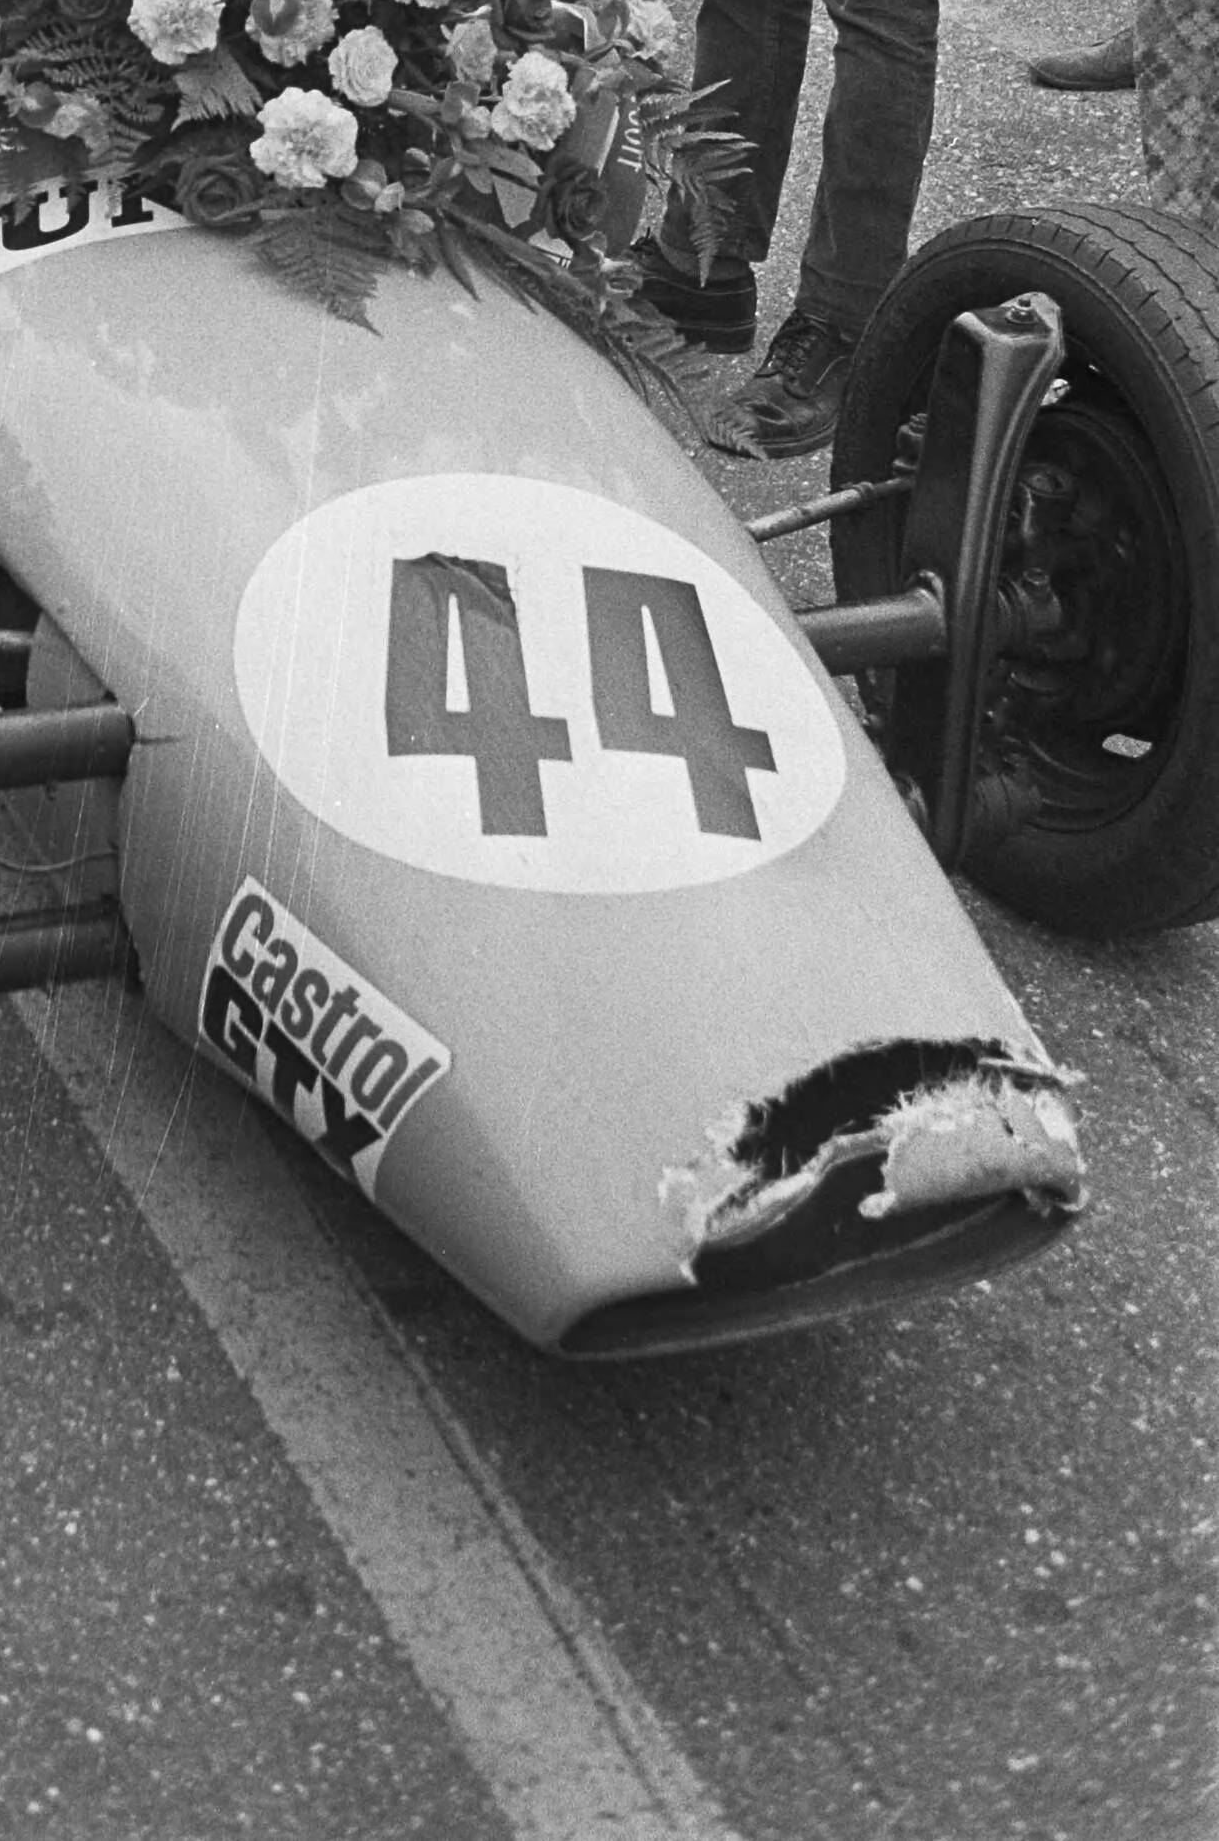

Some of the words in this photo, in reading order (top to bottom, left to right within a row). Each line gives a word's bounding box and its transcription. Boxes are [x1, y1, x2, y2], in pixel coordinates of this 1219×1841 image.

[385, 551, 778, 842] 44
[201, 964, 385, 1184] GTX
[221, 893, 442, 1135] Castrol
